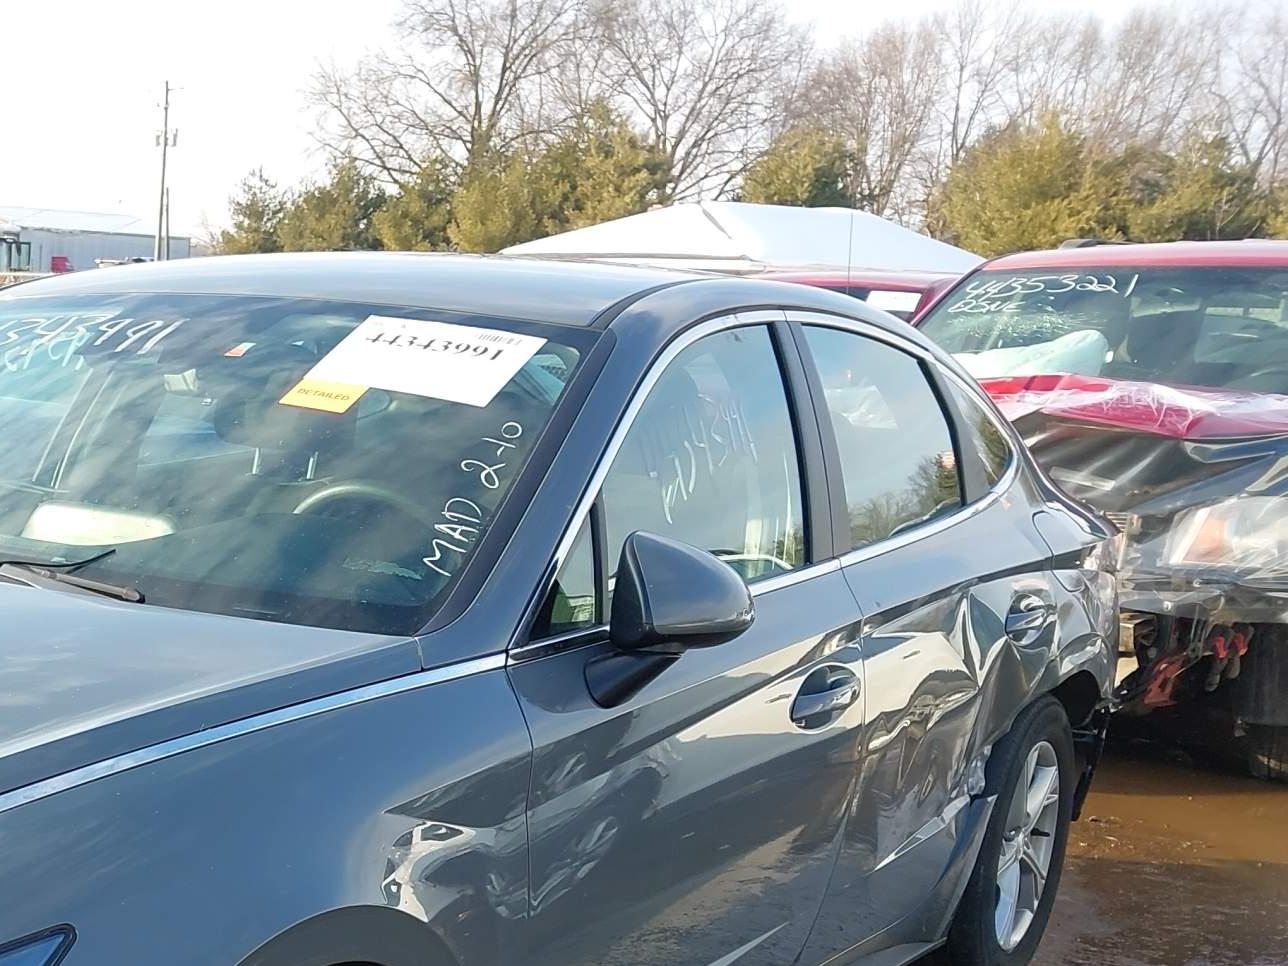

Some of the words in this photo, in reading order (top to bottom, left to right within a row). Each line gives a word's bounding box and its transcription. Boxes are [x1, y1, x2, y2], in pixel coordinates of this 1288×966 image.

[965, 273, 1139, 301] 44353221
[365, 331, 505, 361] 44343991
[296, 387, 351, 401] DETAILED
[422, 497, 483, 577] MAD
[460, 421, 523, 489] 2-10
